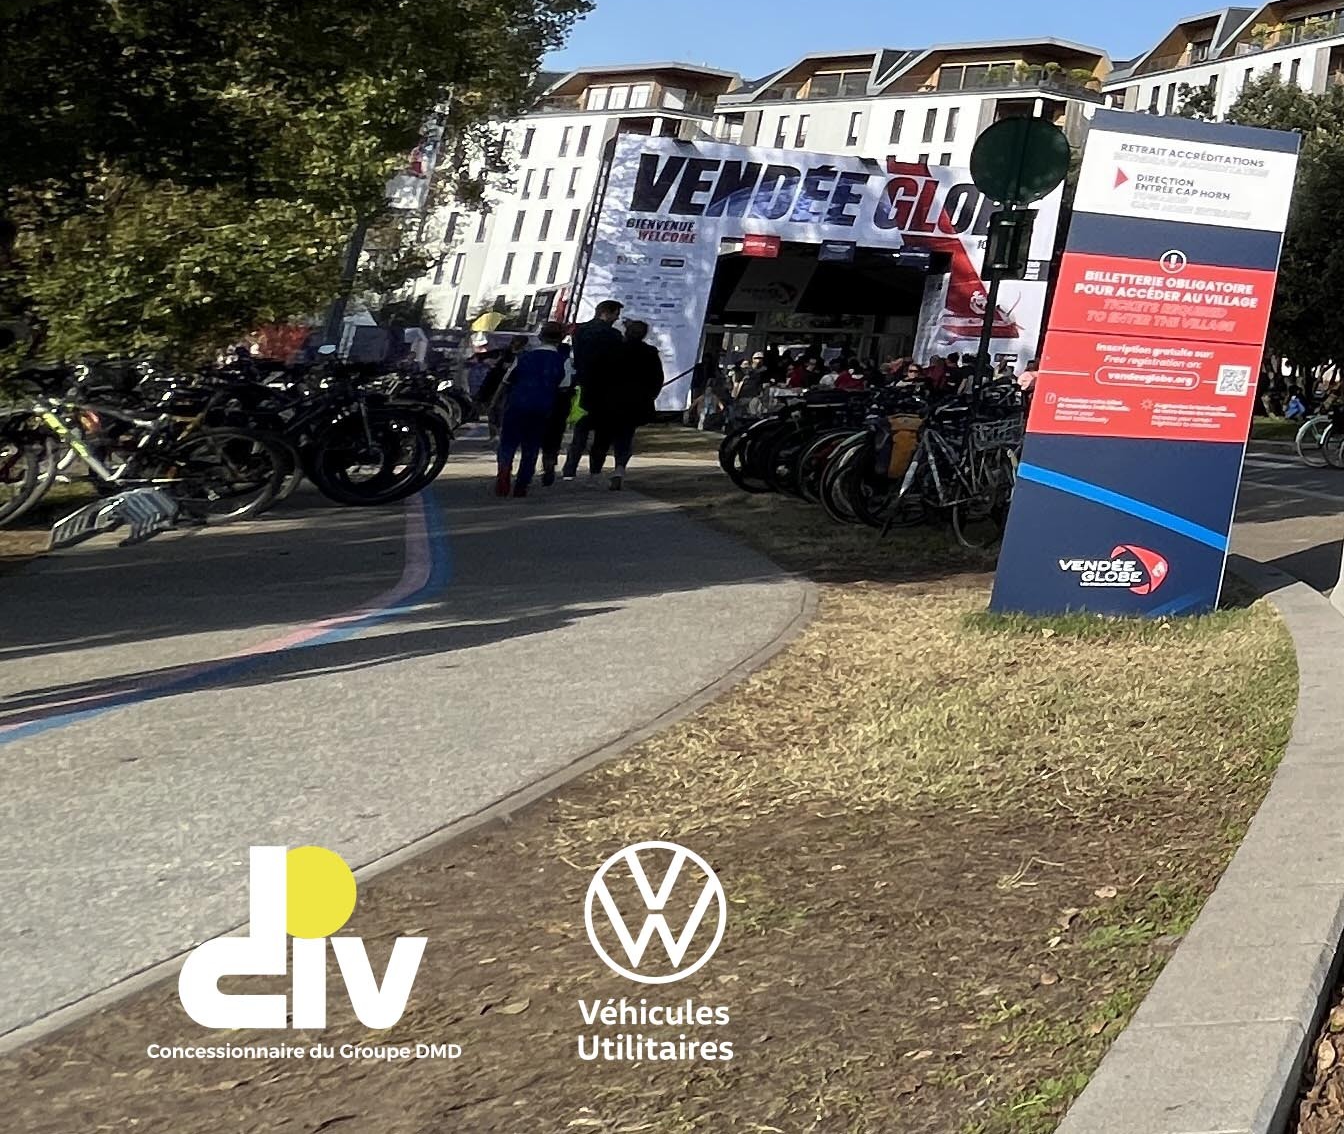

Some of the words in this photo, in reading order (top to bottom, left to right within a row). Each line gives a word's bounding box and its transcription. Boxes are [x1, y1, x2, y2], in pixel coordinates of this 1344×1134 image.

[1121, 144, 1166, 155] RETRAIT
[1168, 149, 1265, 167] ACCRÉDITATIONS
[1136, 174, 1194, 187] DIRECTION
[629, 153, 869, 227] VENDÉE
[626, 218, 695, 232] BIENVENUE
[637, 229, 696, 243] WELCOME
[1084, 270, 1164, 287] BILLETTERIE
[1165, 278, 1254, 294] OBLIGATOIRE
[1074, 283, 1114, 295] POUR
[1115, 288, 1181, 302] ACCÉDER
[1183, 294, 1202, 304] AU
[1204, 296, 1258, 308] VILLAGE
[1059, 559, 1137, 572] VENDÉE
[1081, 570, 1143, 583] GLOBE
